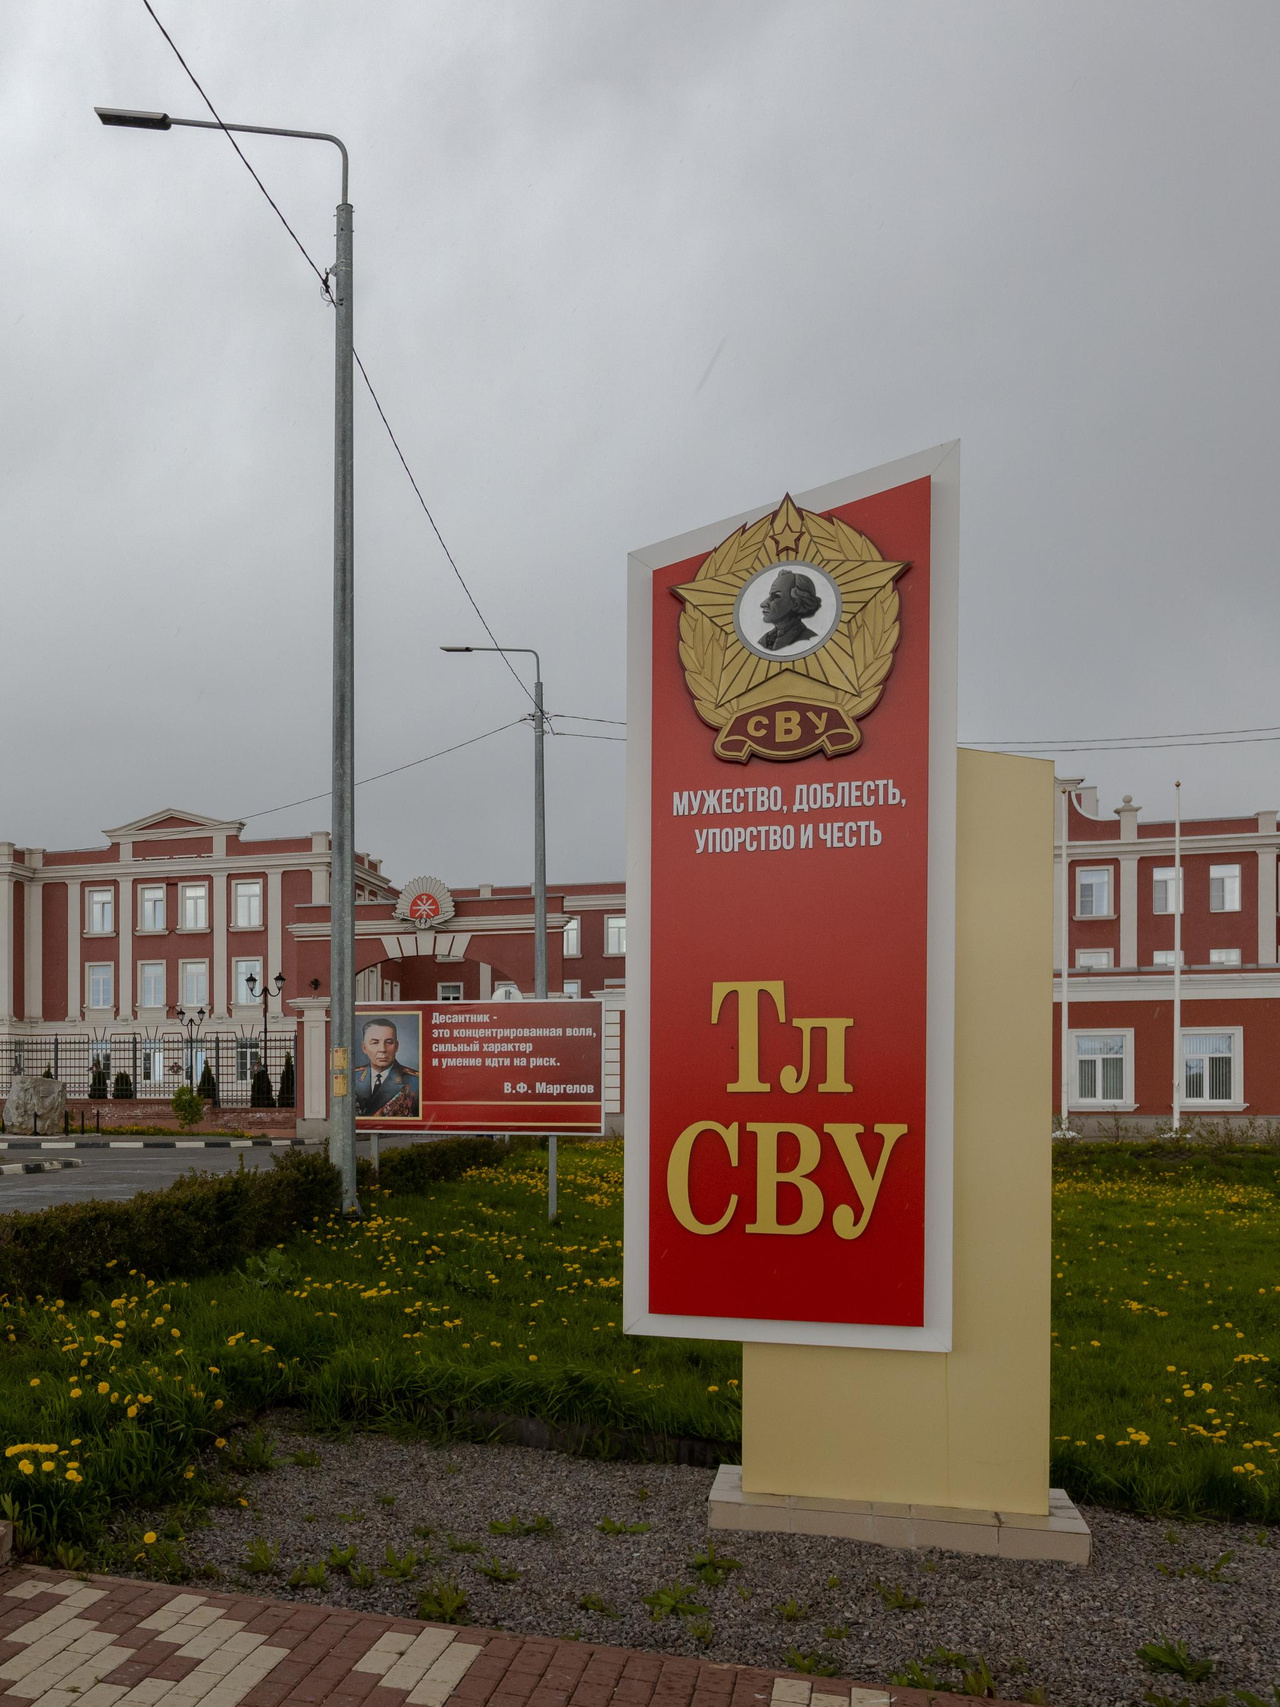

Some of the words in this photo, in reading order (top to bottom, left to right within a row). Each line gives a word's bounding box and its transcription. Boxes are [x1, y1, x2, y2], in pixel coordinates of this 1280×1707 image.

[746, 710, 828, 743] СВУ
[672, 786, 788, 816] МУЖЕСТВО,
[792, 779, 907, 813] ДОБЛЕСТЬ,
[694, 824, 795, 854] УПОРСТВО
[800, 823, 813, 849] И
[818, 820, 883, 849] ЧЕСТЬ
[431, 1012, 490, 1025] Десантник
[432, 1028, 450, 1038] это
[453, 1027, 563, 1039] концентрированная
[565, 1027, 597, 1038] воля,
[432, 1041, 480, 1052] сильный
[482, 1042, 533, 1053] характер
[432, 1057, 439, 1066] и
[442, 1057, 482, 1068] умение
[485, 1057, 511, 1068] идти
[513, 1057, 527, 1066] на
[529, 1057, 561, 1068] риск.
[503, 1082, 532, 1094] В.Ф.
[535, 1082, 595, 1096] Маргелов
[666, 1120, 908, 1240] СВУ
